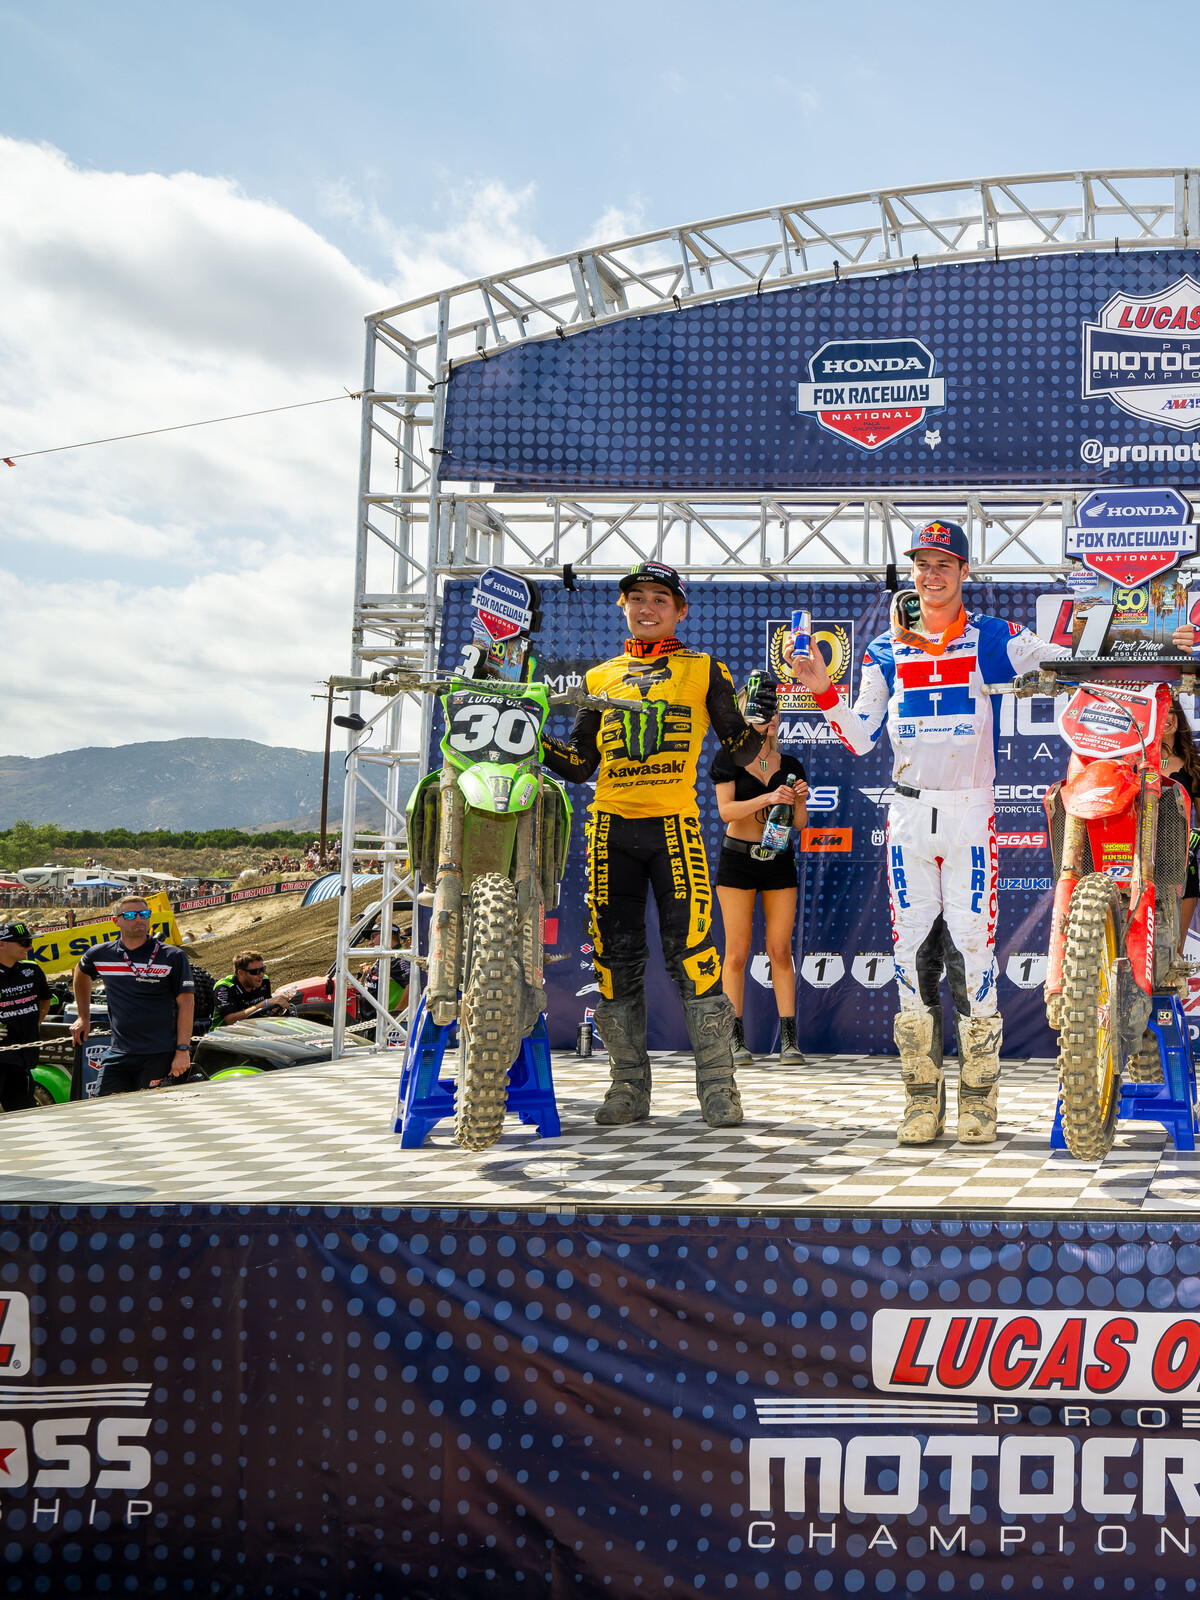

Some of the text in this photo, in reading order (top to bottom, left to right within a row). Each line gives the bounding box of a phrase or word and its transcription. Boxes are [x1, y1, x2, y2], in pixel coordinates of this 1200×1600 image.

[822, 357, 926, 373] HONDA
[813, 384, 930, 405] FOX RACEWAY
[1160, 398, 1195, 410] AMA
[831, 411, 912, 421] NATIONAL
[1107, 505, 1179, 517] HONDA
[920, 535, 951, 545] Red Bull
[1076, 532, 1104, 548] FOX
[1107, 531, 1177, 547] RACEWAY
[1095, 554, 1166, 562] NATIONAL
[493, 582, 526, 602] HONDA
[1117, 588, 1146, 610] 50
[476, 593, 523, 622] FOX RACEWAY
[482, 612, 515, 630] NATIONAL
[1076, 604, 1116, 658] 1
[491, 641, 507, 657] 50
[1110, 640, 1165, 652] First Place
[454, 644, 481, 679] 3
[467, 695, 504, 704] LUCAS
[1092, 703, 1114, 713] LUCAS
[1082, 712, 1130, 727] MOTOCROSS
[449, 704, 540, 755] 30
[1101, 741, 1121, 749] LEADER
[607, 760, 686, 779] Kawasaki
[635, 779, 683, 787] CIRCUIT
[994, 785, 1050, 799] EICO
[810, 834, 843, 846] KTM
[997, 835, 1044, 846] SGAS
[597, 814, 611, 906] SUPER TRICK
[663, 817, 687, 900] SUPER TRICK
[891, 845, 911, 909] HRC
[970, 845, 986, 914] HRC
[997, 878, 1053, 890] UZUKI
[1144, 906, 1156, 984] DUNLOP
[889, 1316, 1139, 1394] LUCAS
[993, 1403, 1167, 1428] PRO
